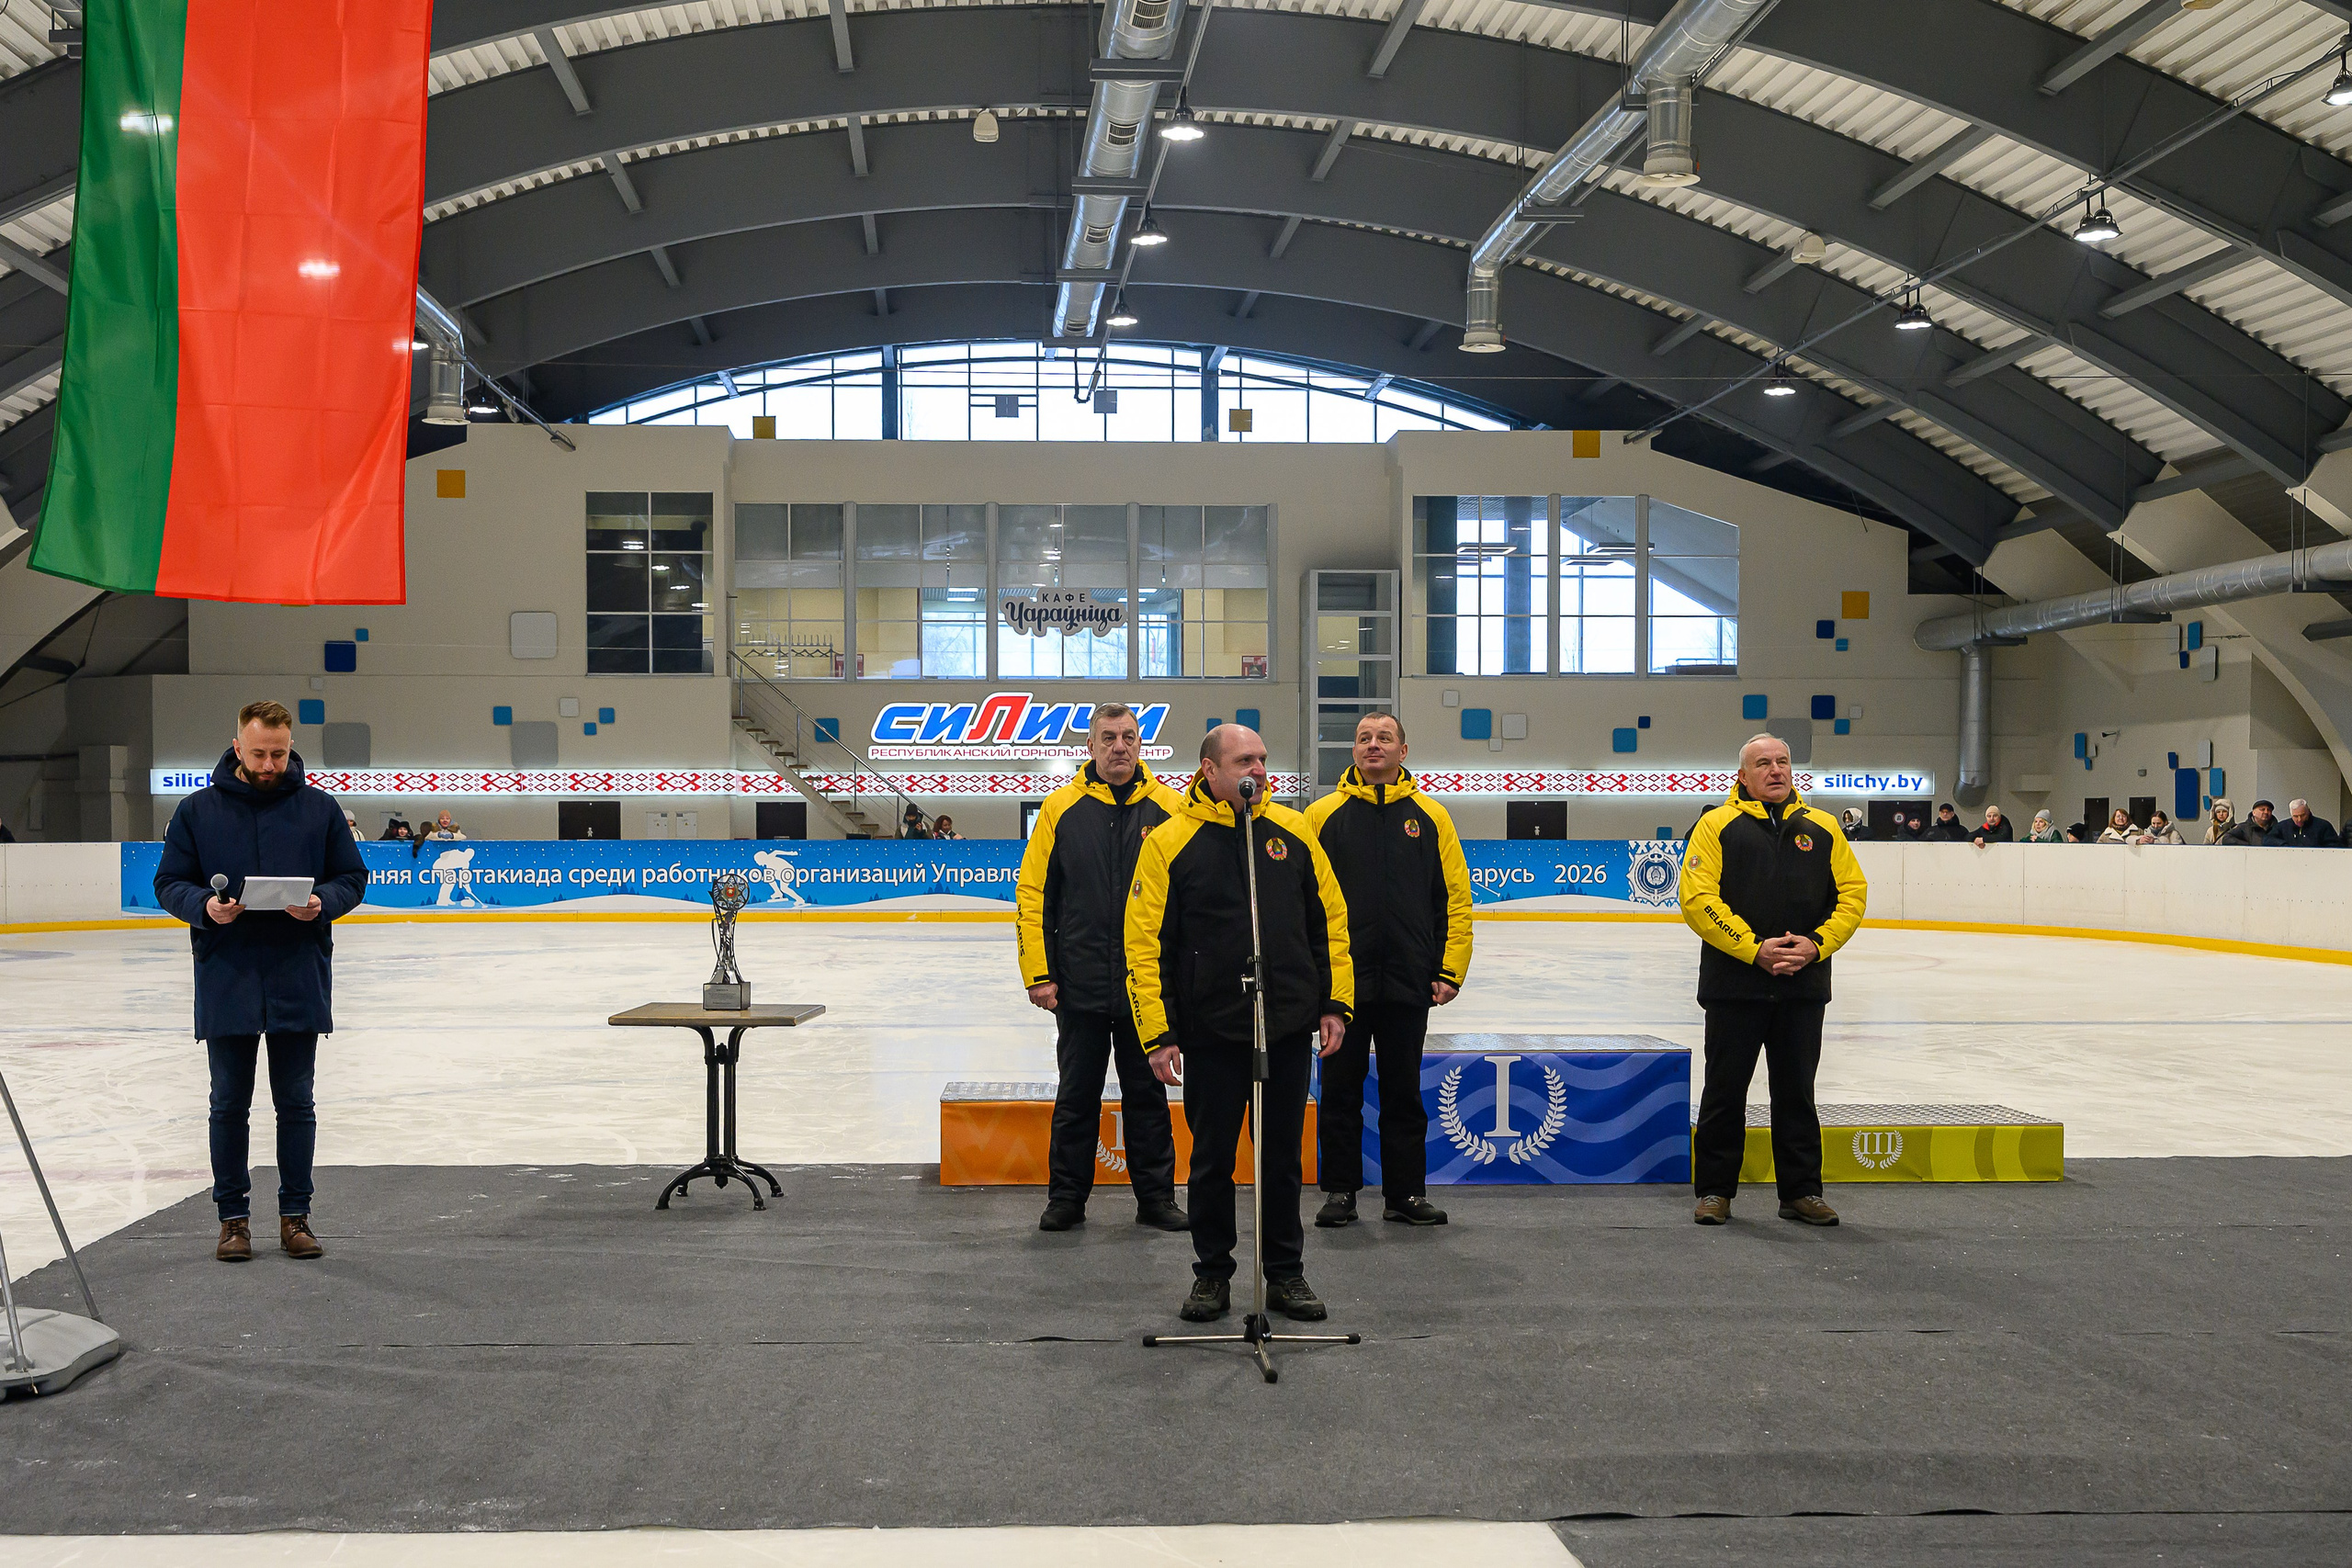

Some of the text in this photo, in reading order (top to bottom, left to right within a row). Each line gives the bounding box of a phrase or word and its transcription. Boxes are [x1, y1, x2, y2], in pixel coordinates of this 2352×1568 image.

[1042, 592, 1085, 603] КАФЕ
[1005, 602, 1123, 632] Чараўніца
[871, 747, 1170, 757] РЕСПУБЛИКАНСКИЙ ГОРНОЛЫЖ ЕНТР
[1825, 774, 1923, 791] silichy.by
[368, 869, 412, 885] няя
[418, 868, 562, 888] спартакиада
[568, 868, 636, 888] среди
[781, 863, 926, 887] организаций
[931, 863, 1020, 887] Управле
[1468, 867, 1535, 888] арусь
[1554, 863, 1608, 885] 2026
[1703, 905, 1742, 942] BELARUS
